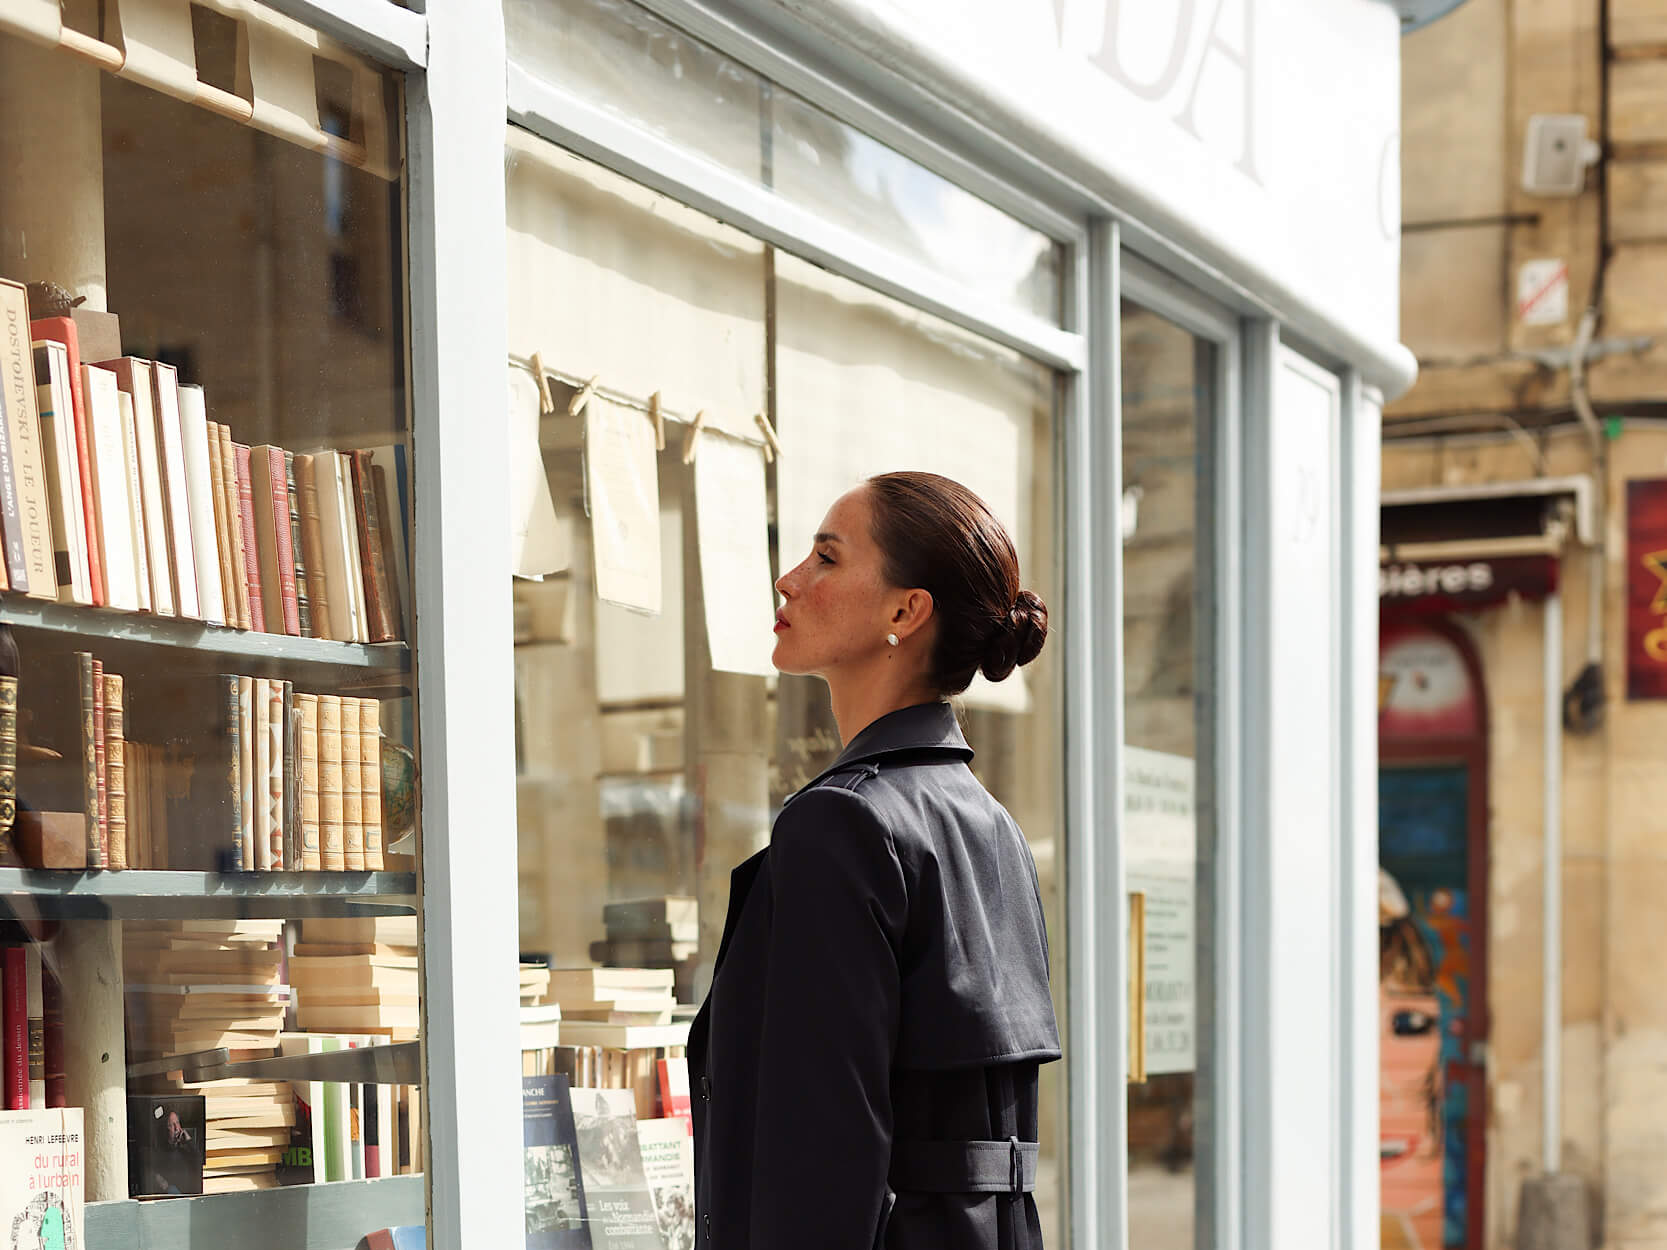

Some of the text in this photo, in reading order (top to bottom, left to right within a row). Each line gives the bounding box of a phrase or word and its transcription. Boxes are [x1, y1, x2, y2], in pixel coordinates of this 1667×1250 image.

[22, 462, 34, 489] LE
[24, 495, 44, 574] JOUEUR
[25, 1135, 45, 1145] HENRI
[34, 1151, 79, 1169] du rural
